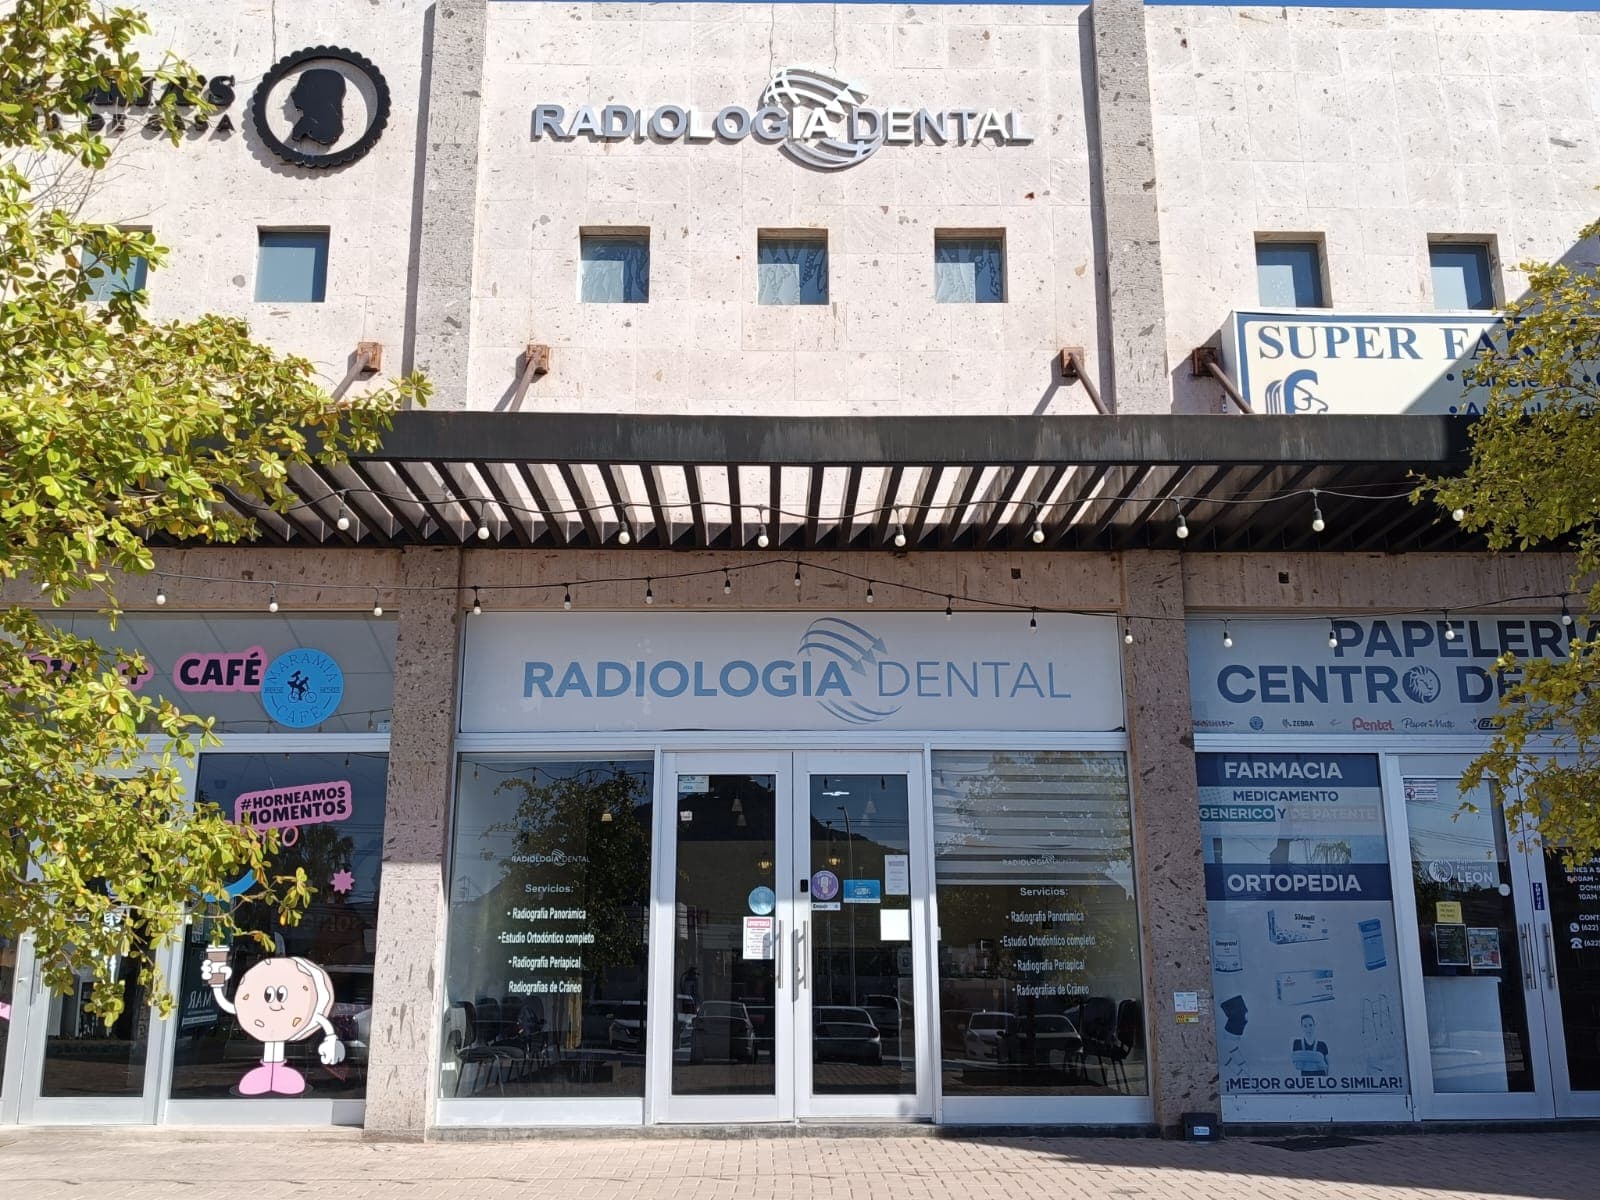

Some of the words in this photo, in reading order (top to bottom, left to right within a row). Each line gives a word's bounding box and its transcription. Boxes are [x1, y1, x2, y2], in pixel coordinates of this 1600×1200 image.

[534, 104, 838, 141] RADIOLOGIA
[851, 106, 1034, 143] DENTAL
[1258, 326, 1424, 360] SUPER
[179, 651, 262, 686] CAFÉ
[522, 659, 852, 698] RADIOLOGIA
[877, 660, 1072, 699] DENTAL
[1292, 719, 1315, 727] ZEBRA
[1352, 716, 1395, 732] Pentel
[1224, 762, 1343, 780] FARMACIA
[240, 786, 346, 811] #HORNEAMOS
[1233, 790, 1339, 802] MEDICAMENTO
[240, 799, 347, 826] MOMENTOS
[1200, 807, 1275, 819] GENERICO
[1277, 808, 1287, 819] Y
[511, 853, 559, 863] RADIOLOGIA
[1227, 873, 1362, 892] ORTOPEDIA
[1457, 871, 1495, 883] LEON
[525, 883, 575, 893] Servicios:
[1020, 887, 1069, 896] Servicios:
[501, 931, 526, 944] Estudio
[565, 931, 595, 946] completo
[549, 955, 582, 971] Periapical
[549, 980, 558, 993] de
[1057, 983, 1066, 996] de
[1226, 1078, 1281, 1092] ¡MEJOR
[1284, 1078, 1314, 1089] QUE
[1318, 1078, 1337, 1089] LO
[1340, 1076, 1403, 1089] SIMILAR!
